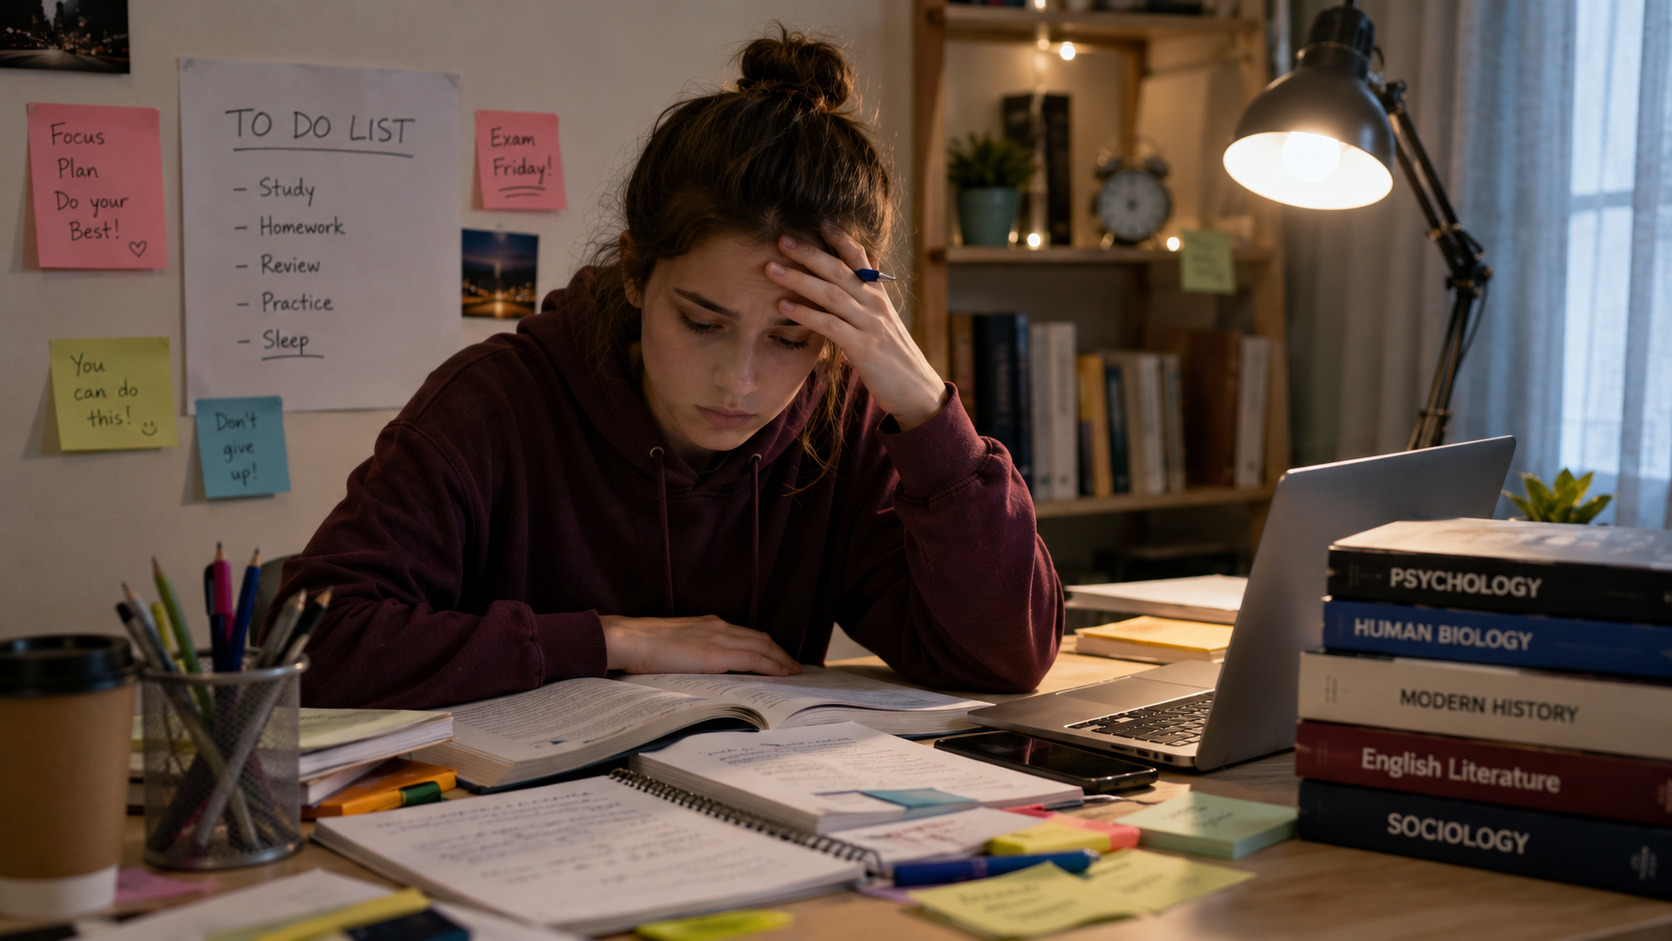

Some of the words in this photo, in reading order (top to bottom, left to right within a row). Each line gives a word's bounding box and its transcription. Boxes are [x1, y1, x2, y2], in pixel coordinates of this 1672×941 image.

[51, 122, 105, 146] Focus
[225, 108, 272, 137] TO
[293, 111, 331, 139] DO
[350, 115, 415, 144] LIST
[490, 126, 535, 147] Exam
[57, 157, 99, 179] Plan
[493, 154, 552, 185] Friday!
[259, 176, 315, 207] Study
[54, 190, 79, 211] Do
[90, 196, 129, 218] your
[69, 218, 119, 241] Best!
[260, 215, 346, 236] Homework
[261, 253, 320, 275] Review
[262, 291, 334, 313] Practice
[263, 328, 309, 356] Sleep
[70, 353, 106, 377] You
[74, 387, 106, 401] can
[118, 379, 139, 398] do
[87, 406, 131, 428] this!
[215, 412, 258, 432] Don't
[223, 440, 255, 464] give
[230, 462, 257, 487] up!
[1389, 567, 1543, 598] PSYCHOLOGY
[1354, 618, 1432, 643] HUMAN
[1438, 624, 1534, 651] BIOLOGY
[1400, 689, 1486, 714] MODERN
[1492, 696, 1580, 724] HISTORY
[1361, 747, 1442, 779] English
[1448, 758, 1562, 794] Literature
[1387, 812, 1530, 855] SOCIOLOGY
